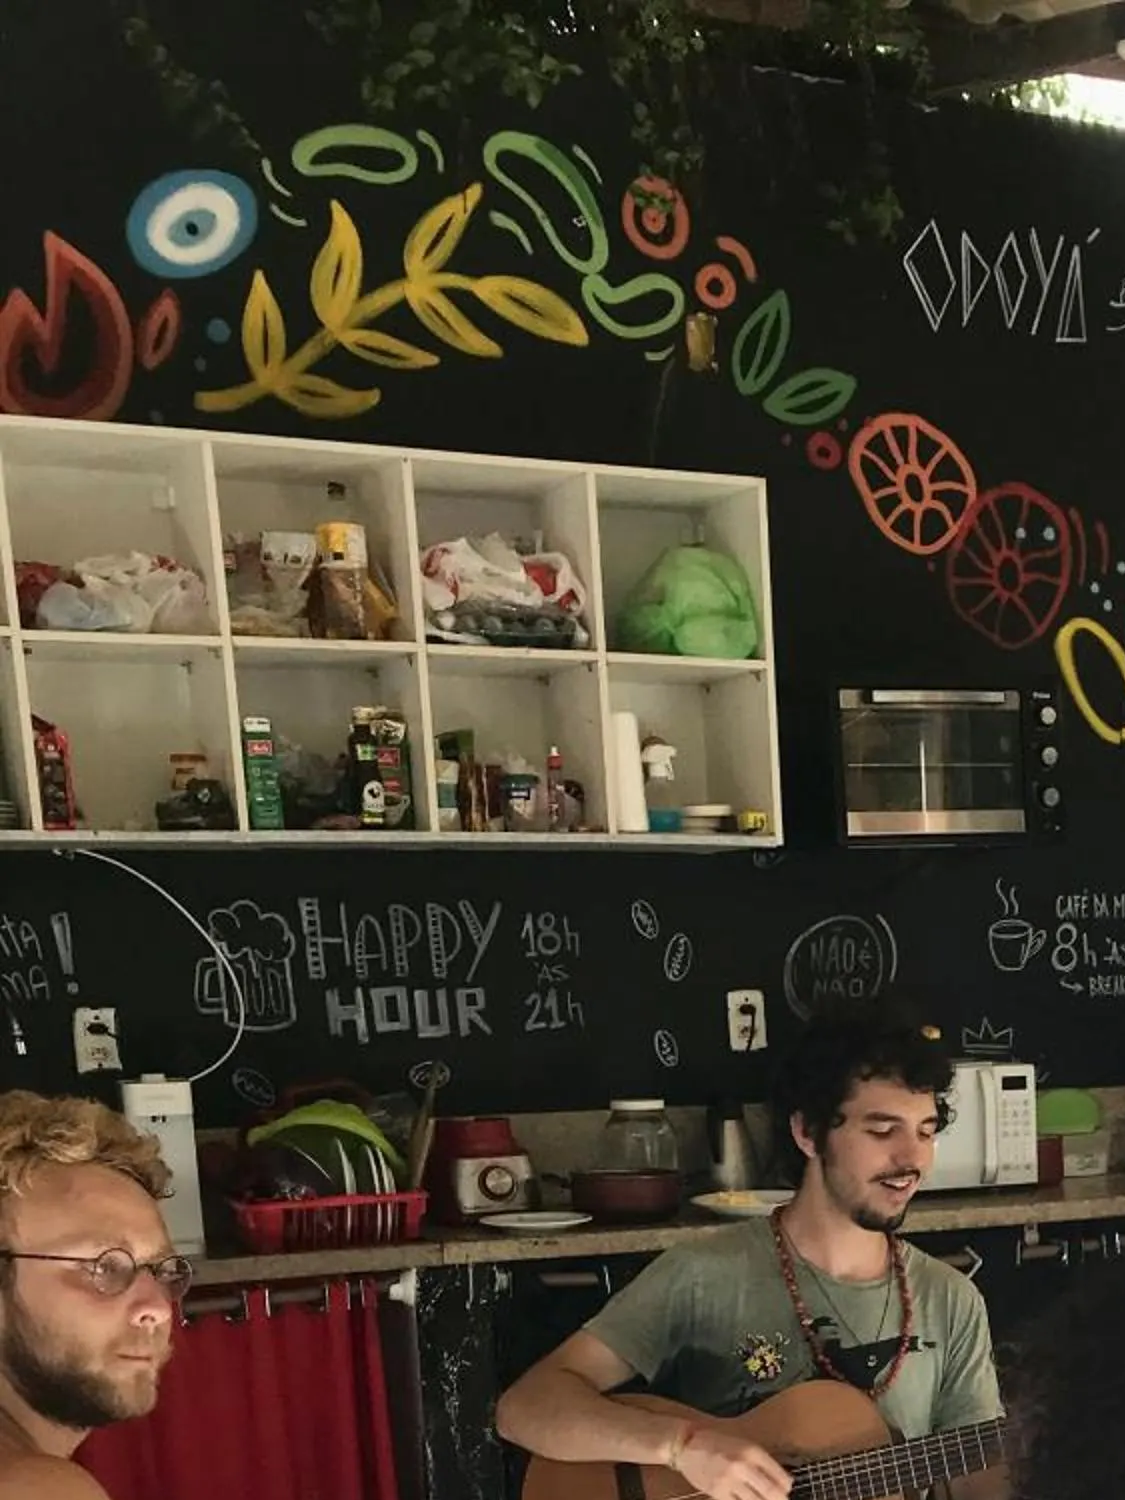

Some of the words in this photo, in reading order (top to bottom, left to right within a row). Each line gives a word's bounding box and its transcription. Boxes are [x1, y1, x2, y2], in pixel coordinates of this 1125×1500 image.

[297, 896, 502, 983] HAPPY
[520, 911, 580, 958] 18h
[1051, 921, 1098, 973] 8h
[324, 984, 494, 1044] HOUR
[524, 985, 586, 1032] 21h
